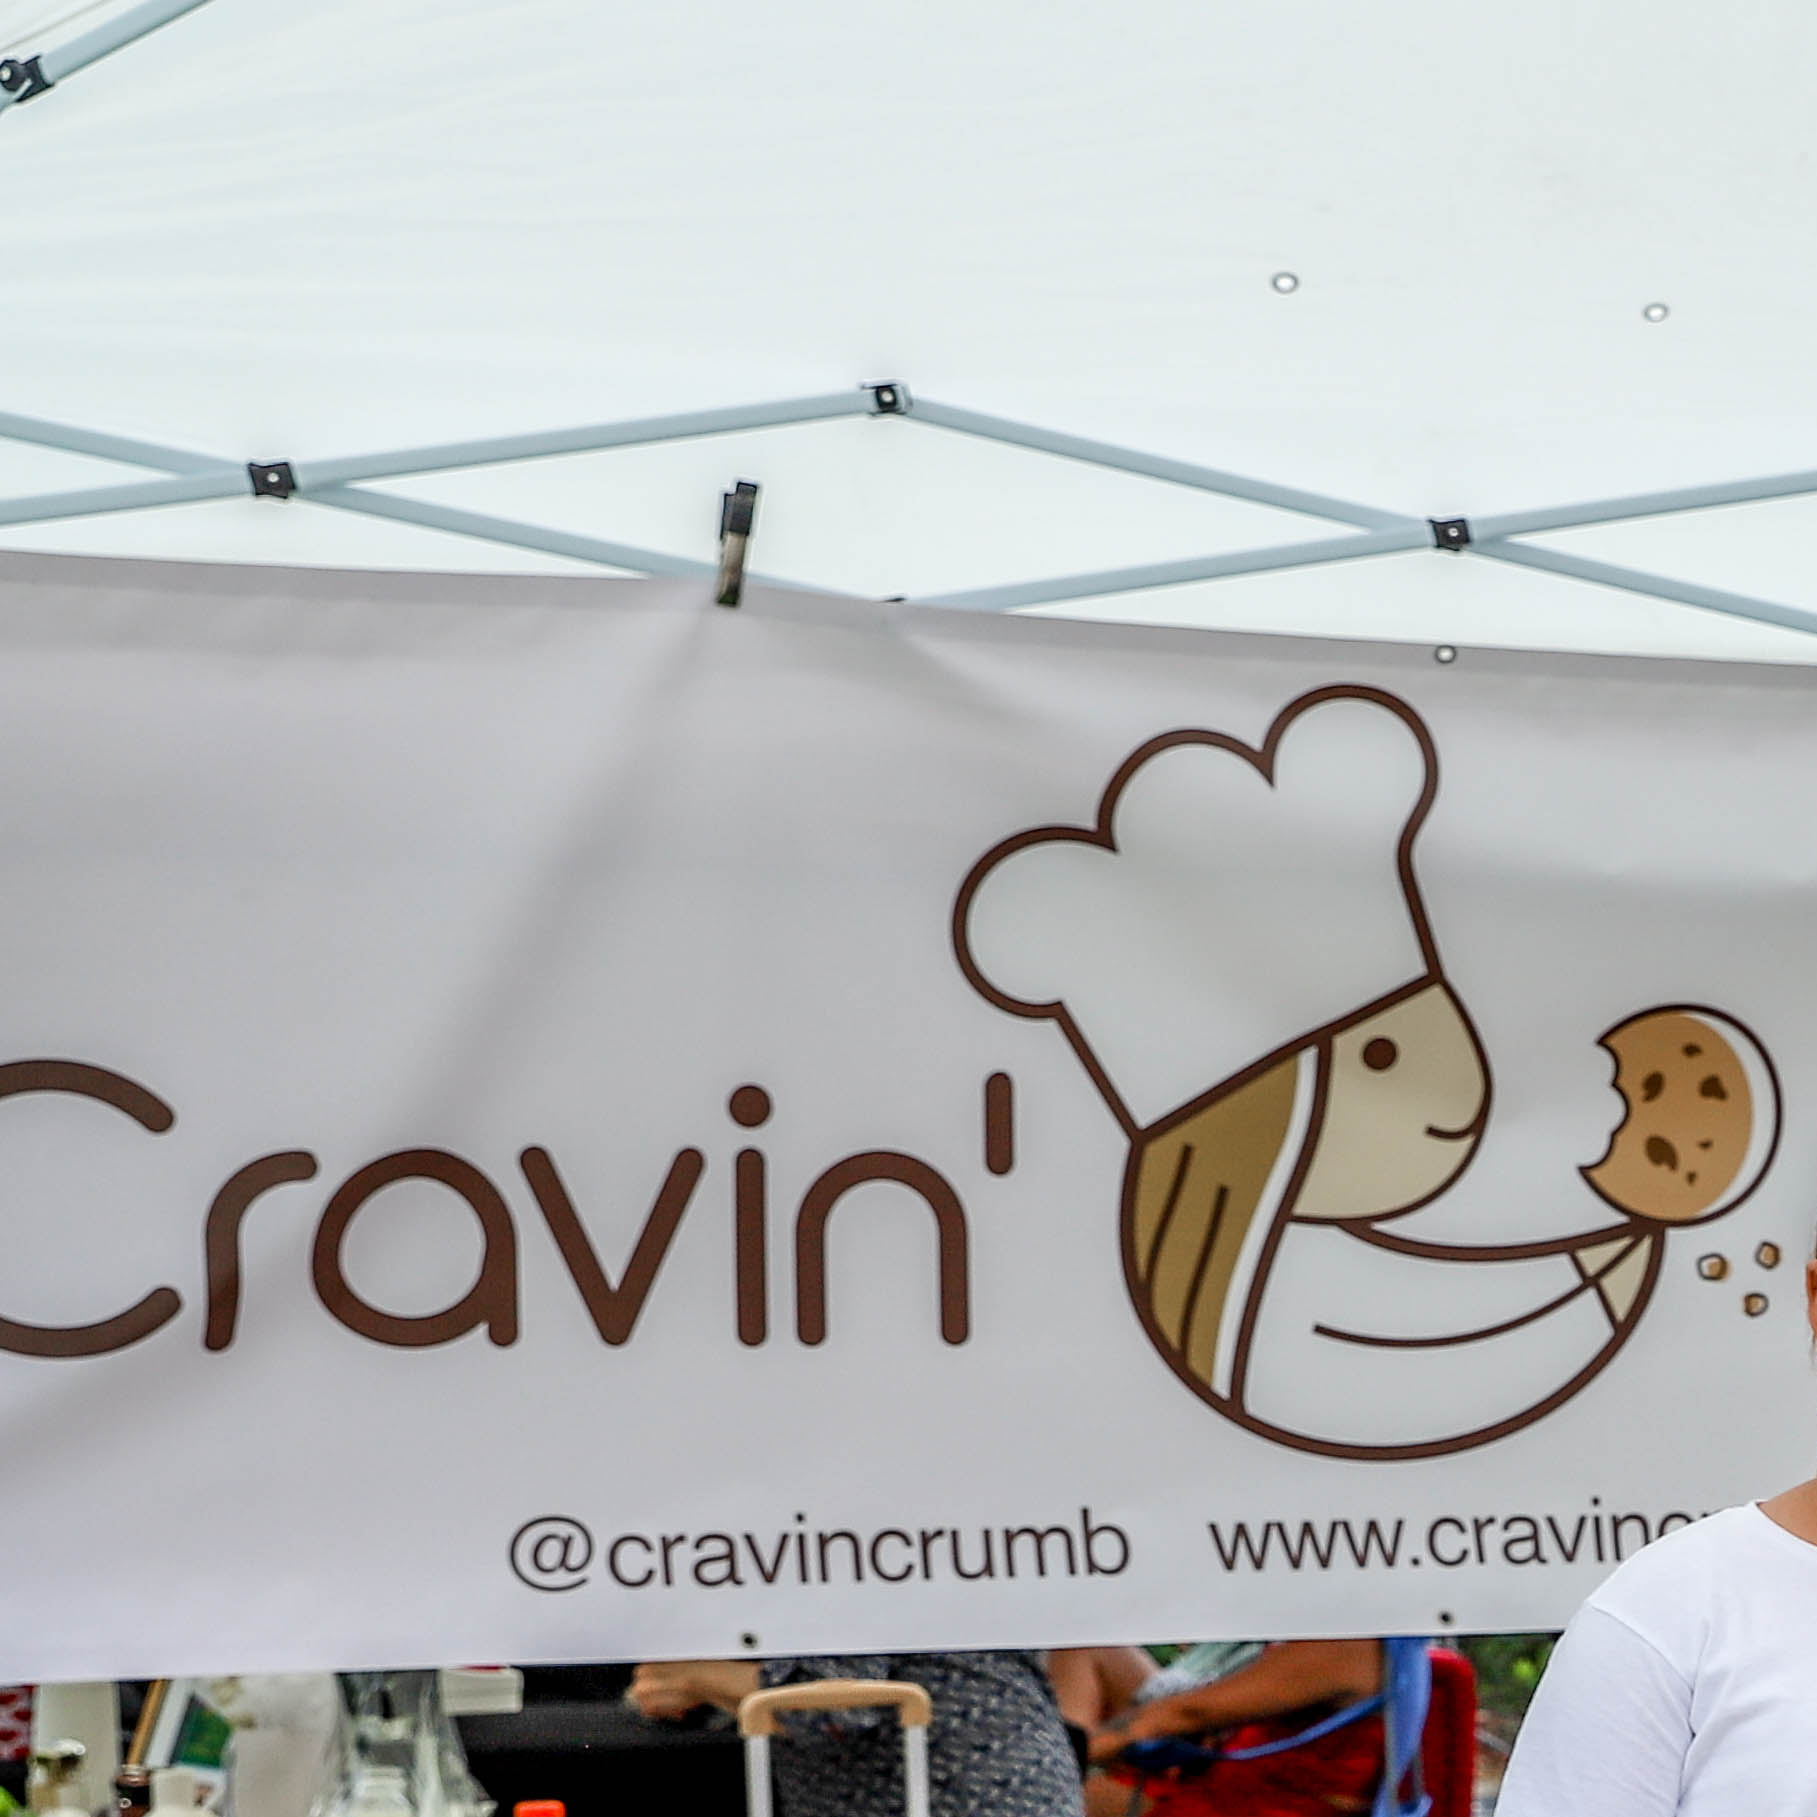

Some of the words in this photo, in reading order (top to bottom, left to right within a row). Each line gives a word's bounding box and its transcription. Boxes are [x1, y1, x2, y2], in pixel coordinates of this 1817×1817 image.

[0, 1057, 1013, 1360] Cravin'
[509, 1507, 1131, 1593] @cravincrumb
[1208, 1496, 1722, 1571] www.cravinc
